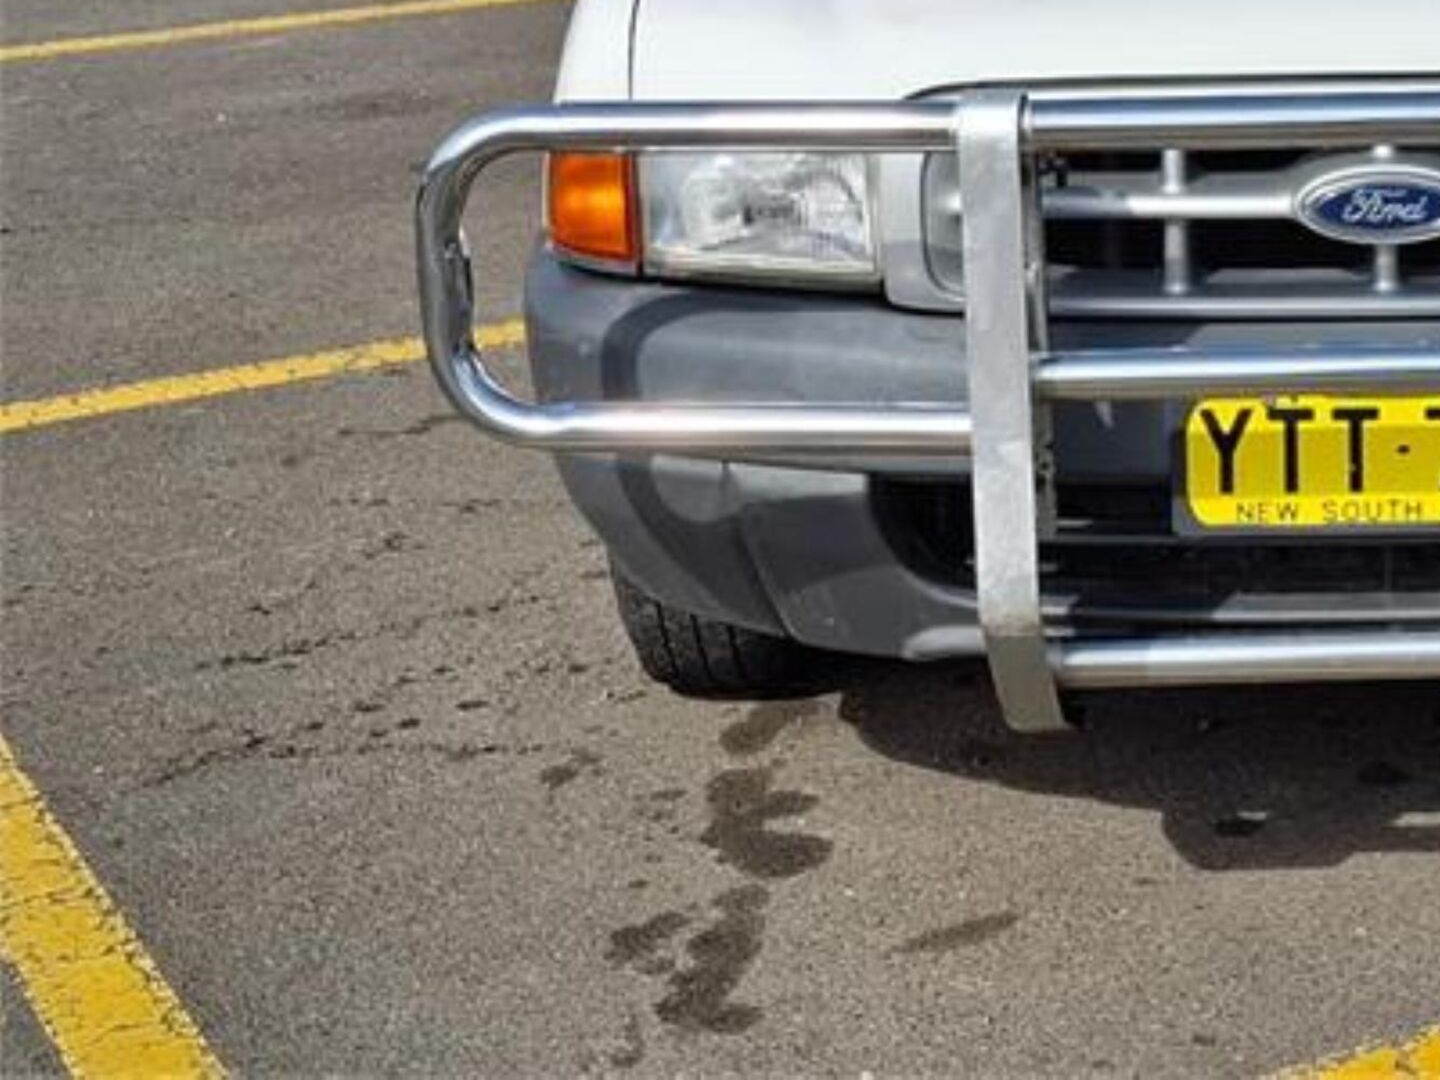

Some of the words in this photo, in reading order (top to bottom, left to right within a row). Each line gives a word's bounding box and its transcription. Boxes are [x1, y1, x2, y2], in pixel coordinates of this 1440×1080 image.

[1342, 188, 1429, 223] Ford
[1236, 502, 1299, 522] NEW
[1321, 500, 1423, 522] SOUTH
